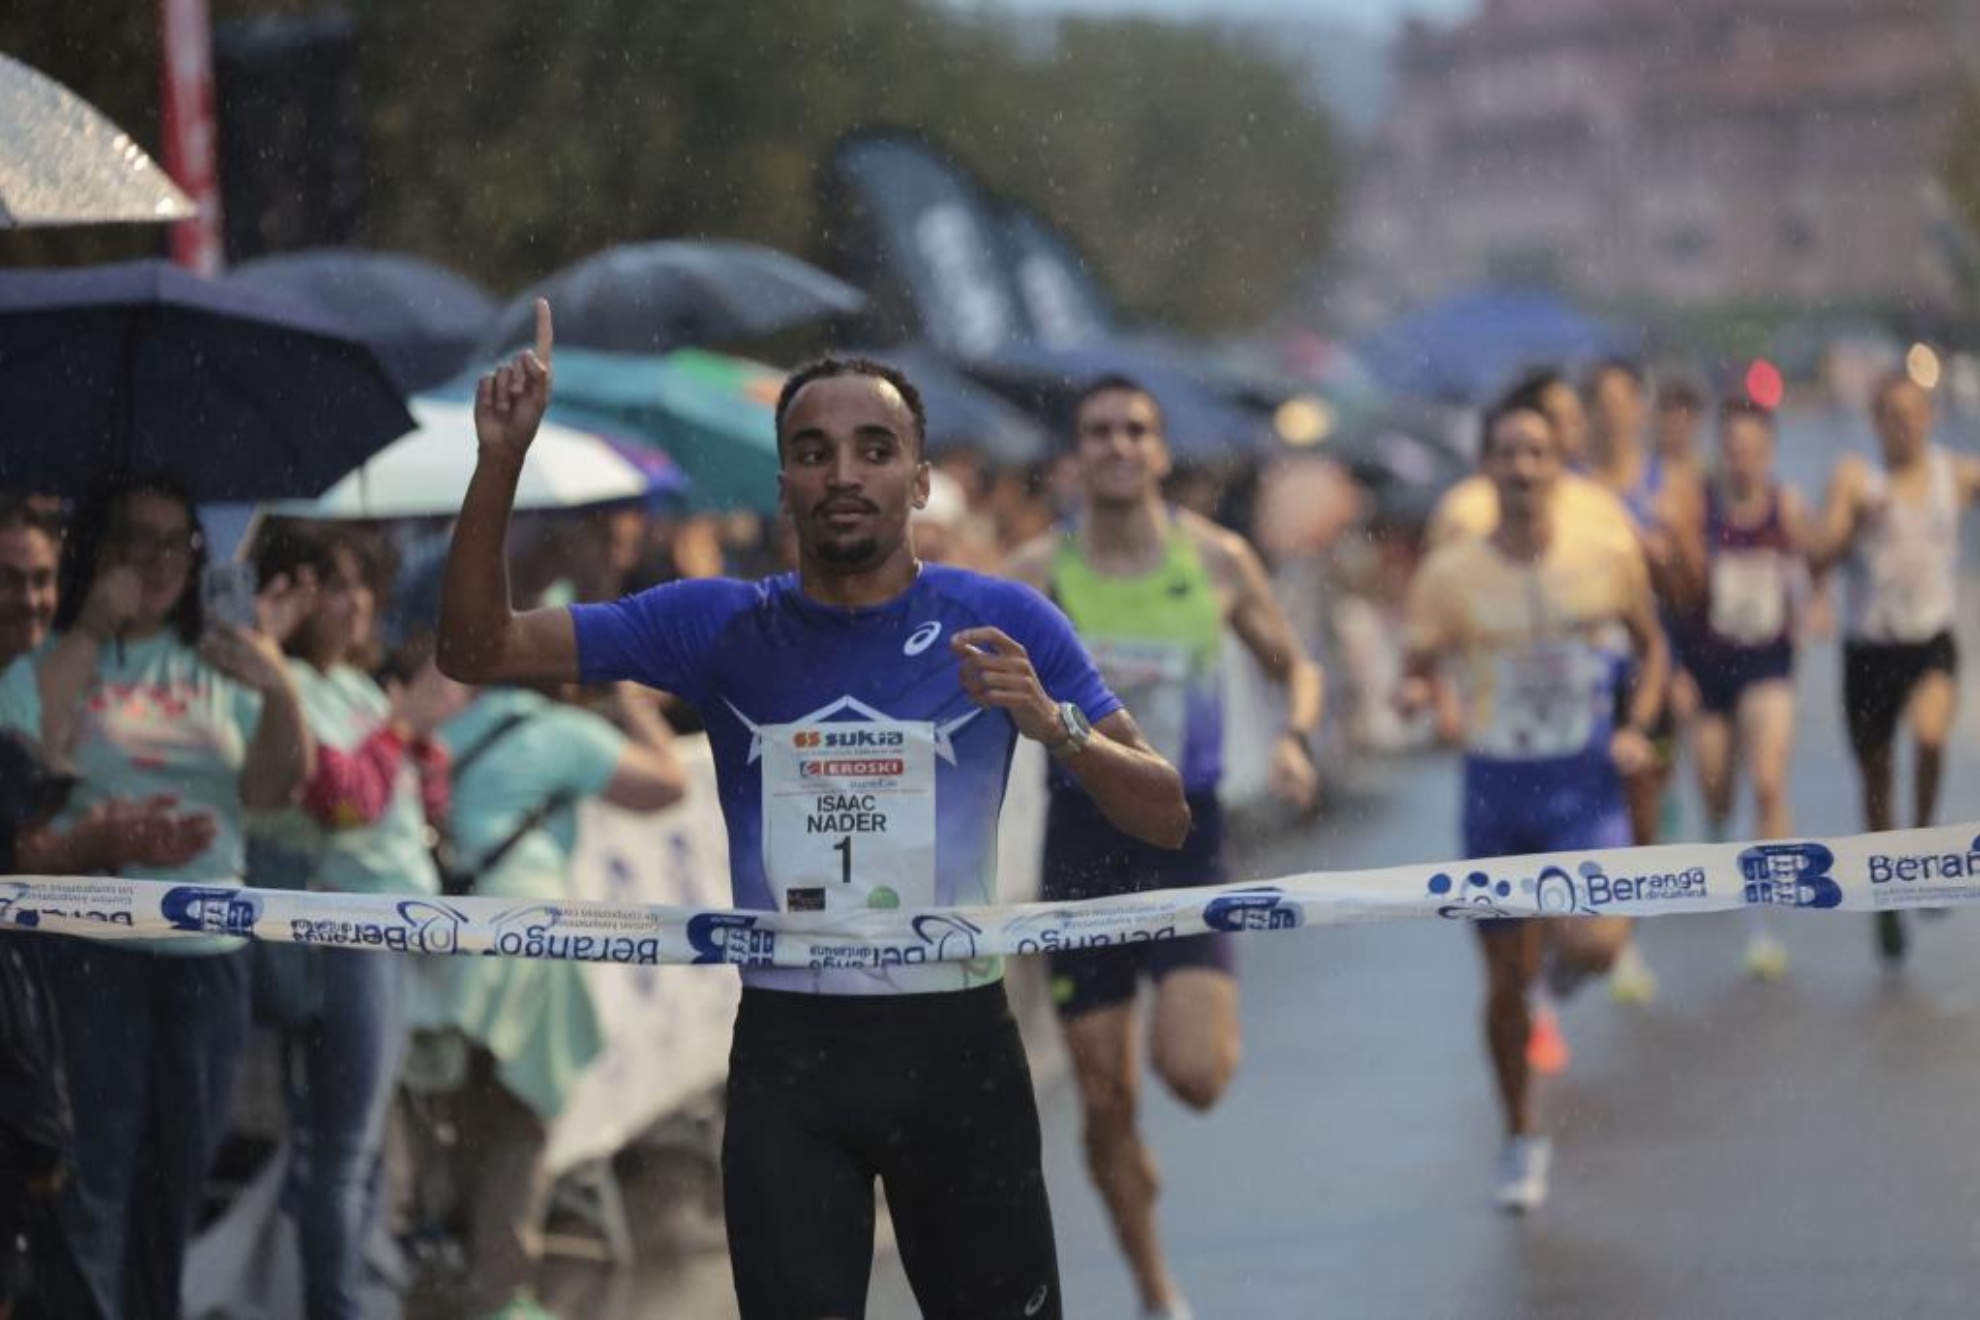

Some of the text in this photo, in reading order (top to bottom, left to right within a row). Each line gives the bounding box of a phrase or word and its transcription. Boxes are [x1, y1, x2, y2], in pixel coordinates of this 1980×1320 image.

[829, 761, 898, 774] EROSKI
[817, 795, 875, 812] ISAAC
[807, 813, 887, 833] NADER
[833, 836, 851, 883] 1
[499, 926, 659, 965] Berango
